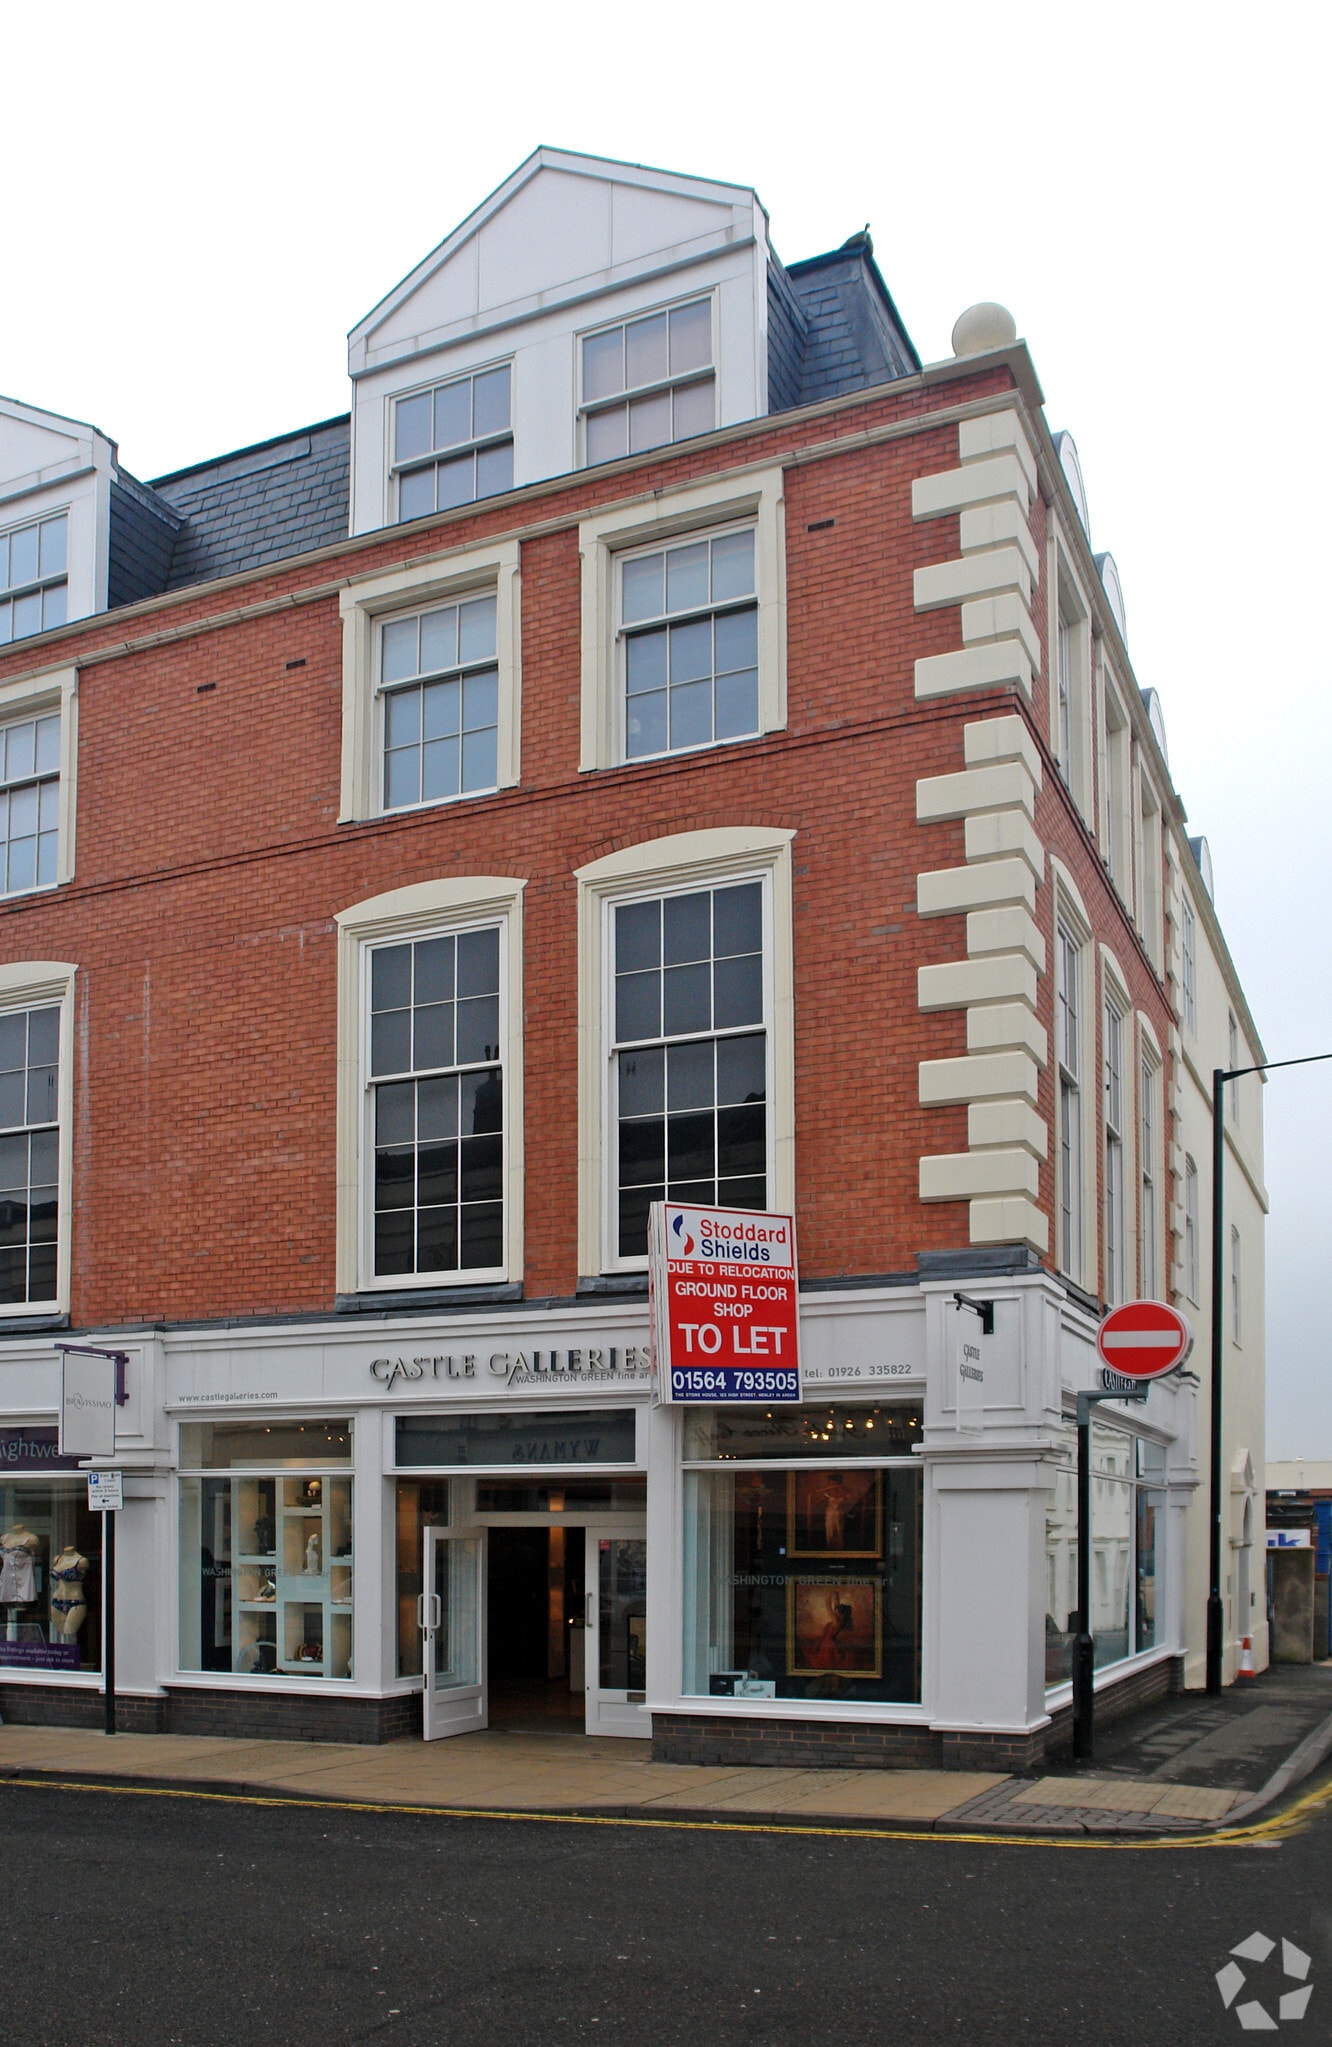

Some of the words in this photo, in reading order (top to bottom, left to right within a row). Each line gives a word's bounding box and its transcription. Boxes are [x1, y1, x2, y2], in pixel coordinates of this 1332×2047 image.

[700, 1219, 786, 1244] Stoddard
[701, 1239, 770, 1261] Shields
[668, 1262, 694, 1274] DUE
[698, 1263, 715, 1276] TO
[719, 1264, 795, 1280] RELOCATION
[675, 1281, 737, 1298] GROUND
[741, 1285, 788, 1301] FLOOR
[713, 1302, 753, 1318] SHOP
[677, 1323, 722, 1354] TO
[732, 1325, 788, 1355] LET
[369, 1353, 476, 1391] CASTLE
[488, 1346, 652, 1386] GALLERIES
[515, 1373, 577, 1384] WASHINGTON
[580, 1372, 614, 1382] GREEN
[617, 1371, 635, 1380] fine
[638, 1372, 652, 1380] ar
[805, 1369, 822, 1378] tel:
[828, 1367, 861, 1377] 01926
[868, 1364, 911, 1375] 335822
[672, 1371, 727, 1391] 01564
[733, 1371, 797, 1391] 793505
[65, 1395, 112, 1409] BRAVISSIMO
